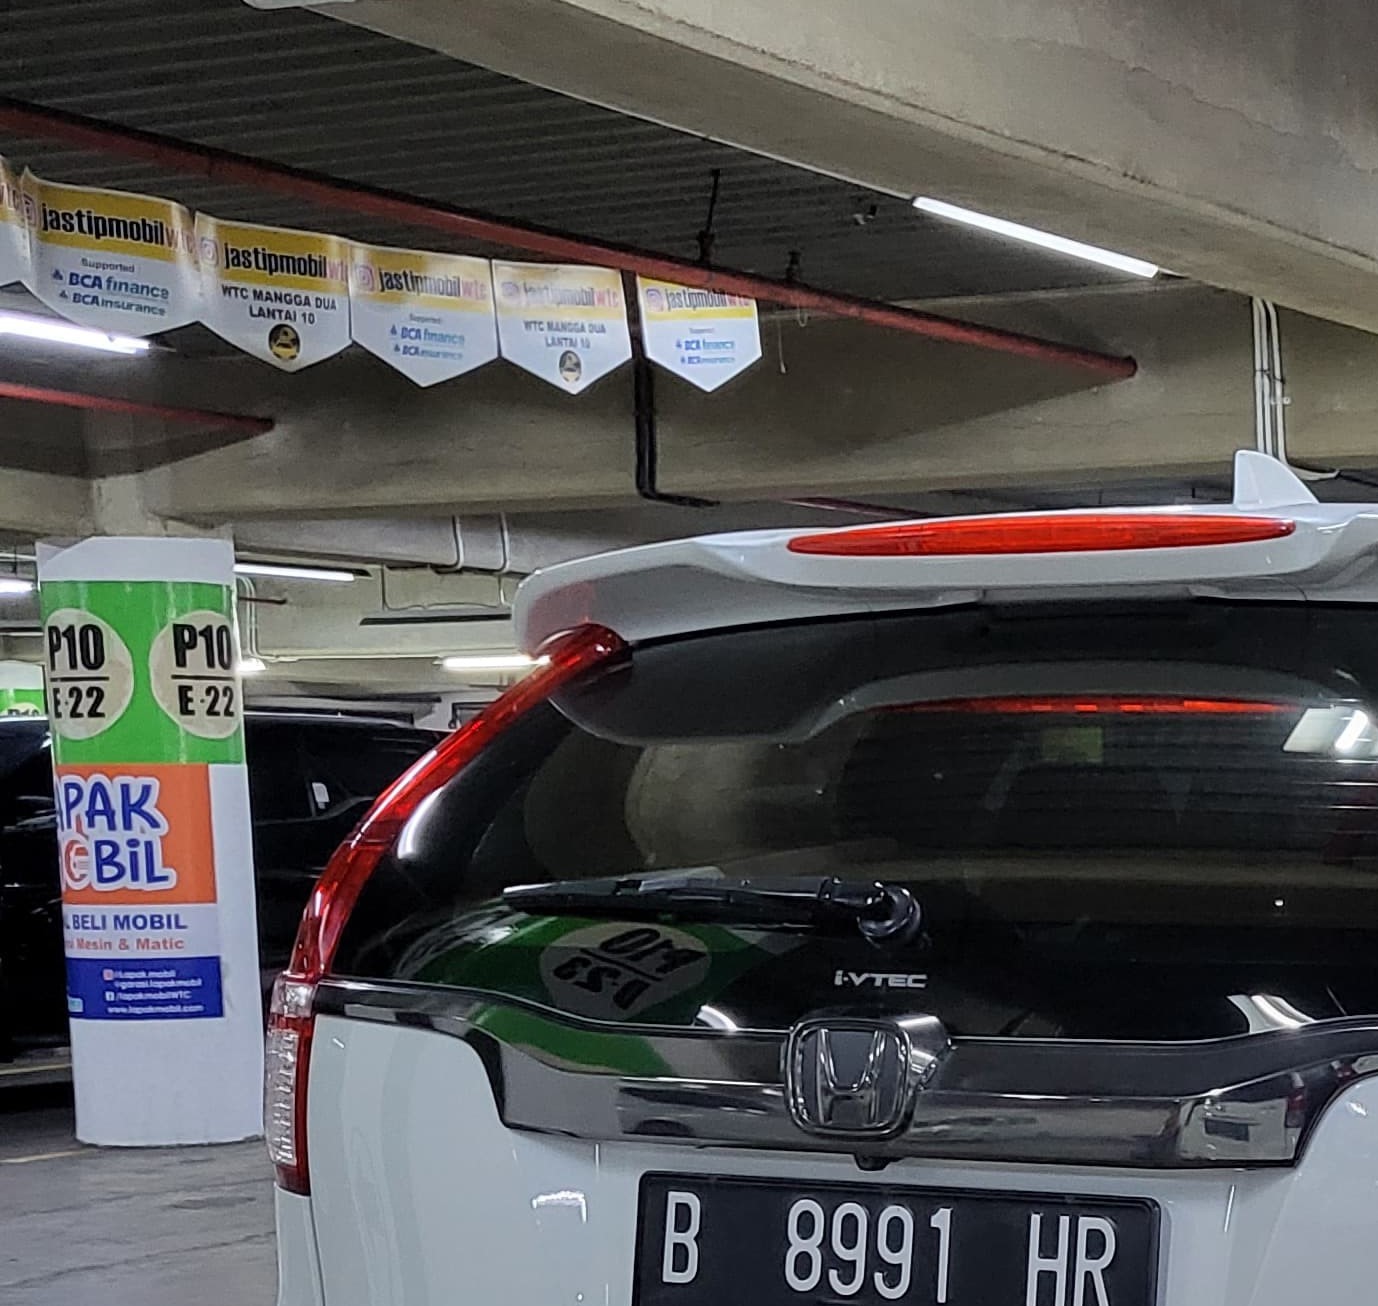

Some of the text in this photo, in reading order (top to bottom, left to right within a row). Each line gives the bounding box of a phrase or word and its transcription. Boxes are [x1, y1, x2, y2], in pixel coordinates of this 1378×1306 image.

[80, 257, 135, 273] Supported
[68, 272, 169, 300] BCA finance
[222, 284, 337, 311] WTC MANGGA DUA
[249, 304, 316, 325] LANTAI 10
[48, 624, 105, 671] P10
[172, 624, 233, 670] P10
[72, 914, 188, 930] BELI MOBIL
[118, 938, 129, 950] &
[136, 938, 185, 950] Matic
[661, 1191, 701, 1284] B
[784, 1198, 953, 1304] 8991
